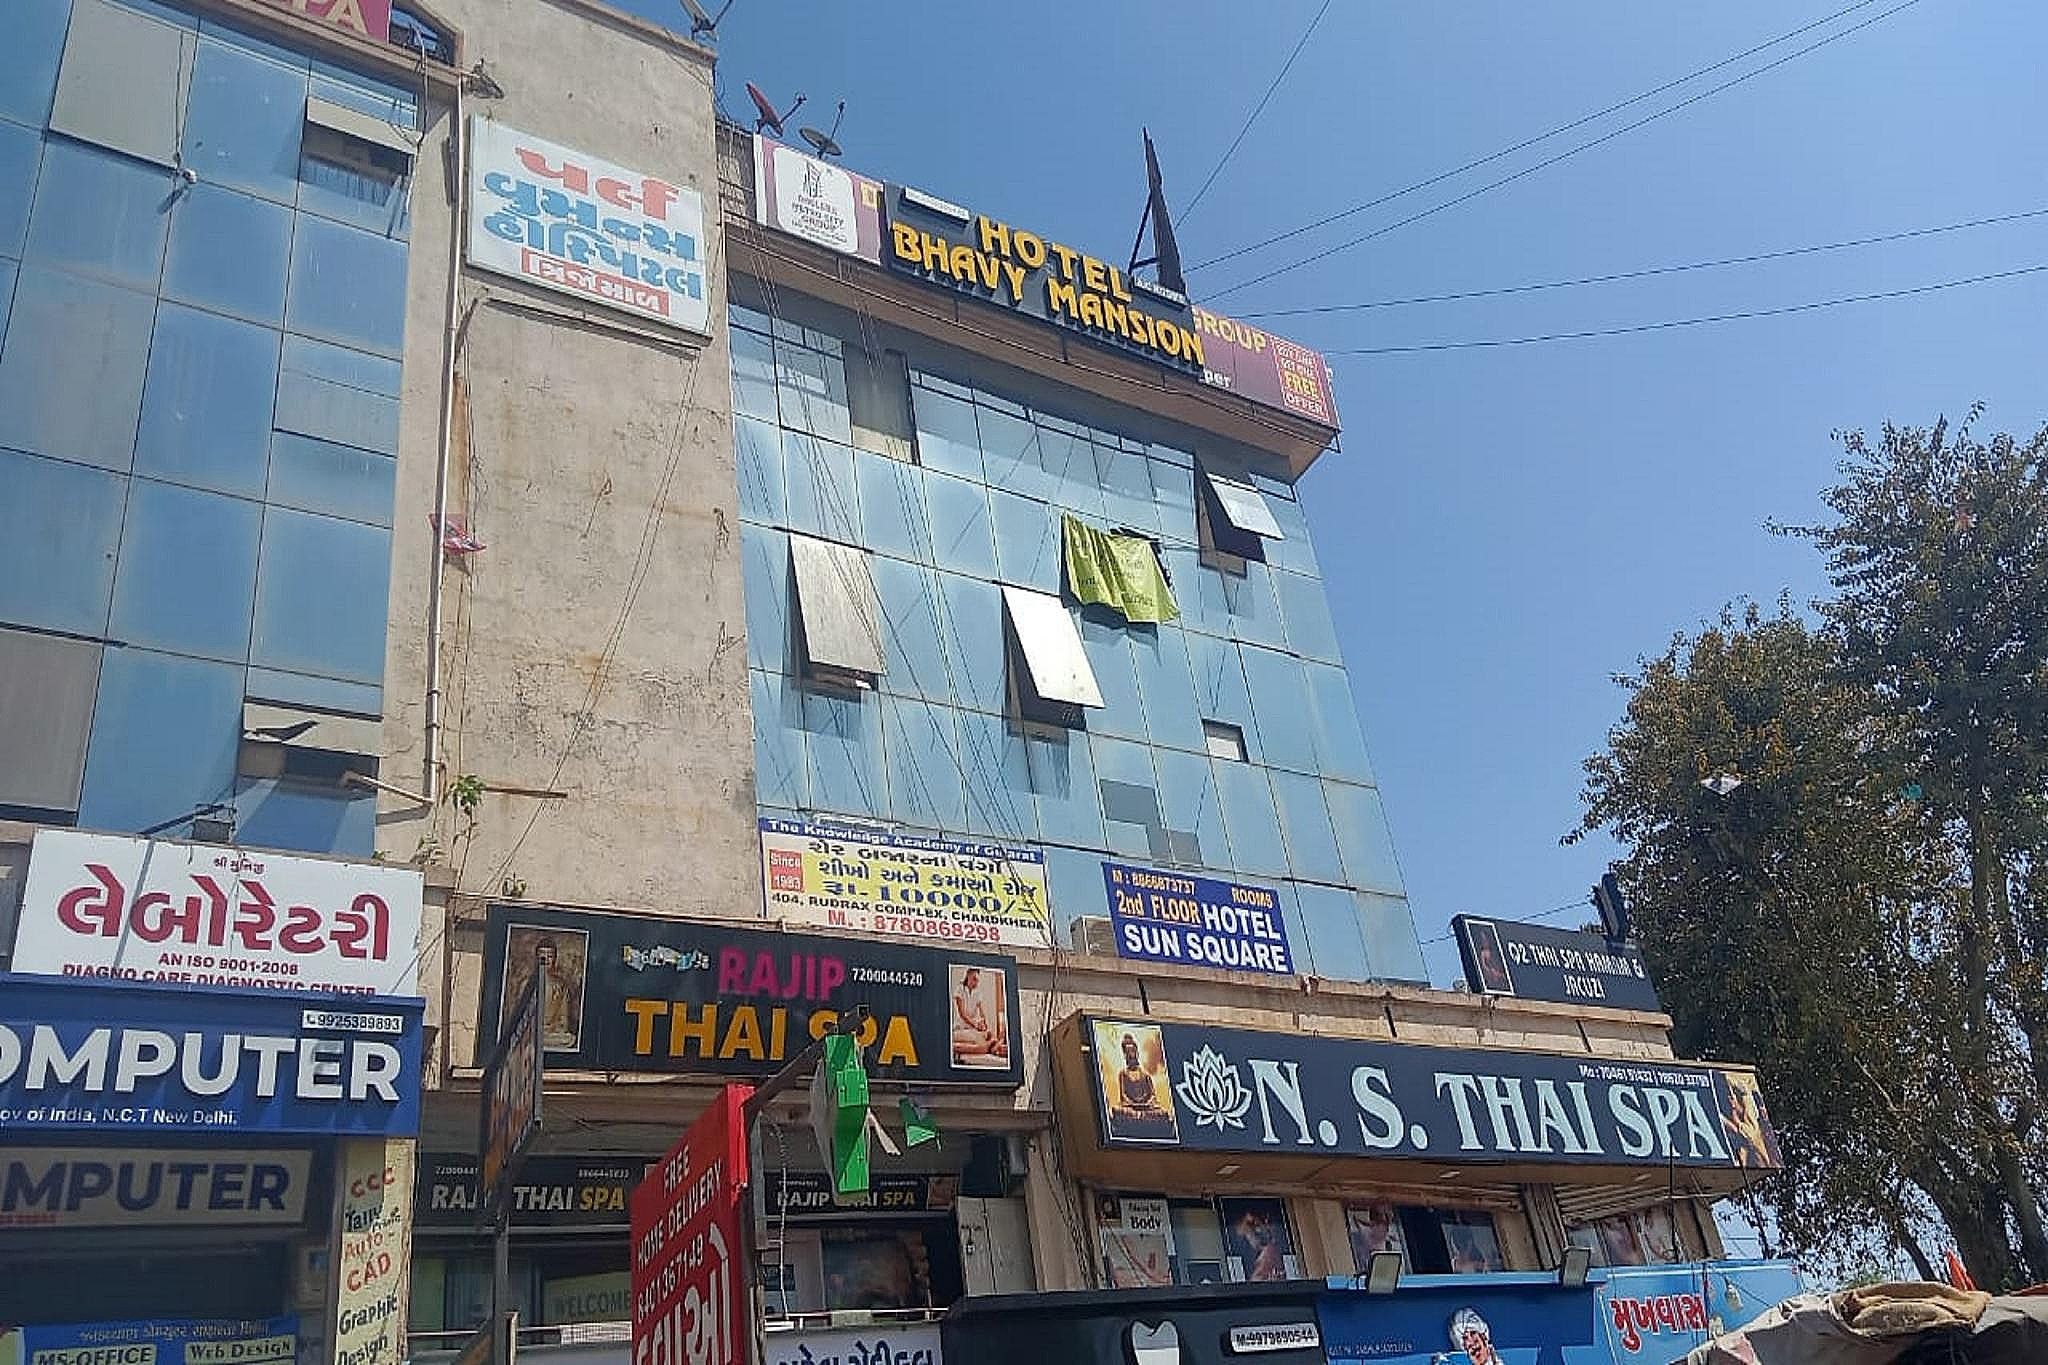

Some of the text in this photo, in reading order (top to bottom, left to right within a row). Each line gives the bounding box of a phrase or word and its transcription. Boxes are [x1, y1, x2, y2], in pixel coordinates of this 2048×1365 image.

[892, 220, 1026, 302] BHAVY
[978, 215, 1132, 302] HOTEL
[1047, 277, 1205, 366] MANSION
[805, 824, 888, 845] Knowledge
[894, 837, 960, 853] Academy
[58, 863, 390, 961] લેબોરેટરી
[808, 896, 870, 911] RUDRAX
[1116, 890, 1282, 941] 2nd FLOOR HOTEL
[1231, 887, 1273, 909] ROOMS
[874, 915, 1000, 941] 8780868298
[1124, 924, 1289, 972] SUN SQUARE
[62, 964, 137, 981] DIAGNO
[142, 970, 191, 985] CARE
[159, 953, 299, 976] AN ISO 9001-2008
[718, 945, 845, 1001] RAJIP
[625, 1000, 786, 1062] THAI
[27, 1107, 47, 1121] of
[50, 1107, 97, 1122] India,
[153, 1109, 188, 1123] New
[193, 1110, 238, 1124] Delhi.
[1248, 1058, 1729, 1160] N. S. THAI SPA
[351, 1167, 395, 1198] CCC
[663, 1145, 690, 1198] FREE
[512, 1185, 574, 1210] THAI
[578, 1185, 625, 1210] SPA
[638, 1158, 722, 1273] HOME DELIVERY
[777, 1191, 830, 1207] RAJIP
[882, 1191, 916, 1206] SPA
[346, 1252, 392, 1292] CAD
